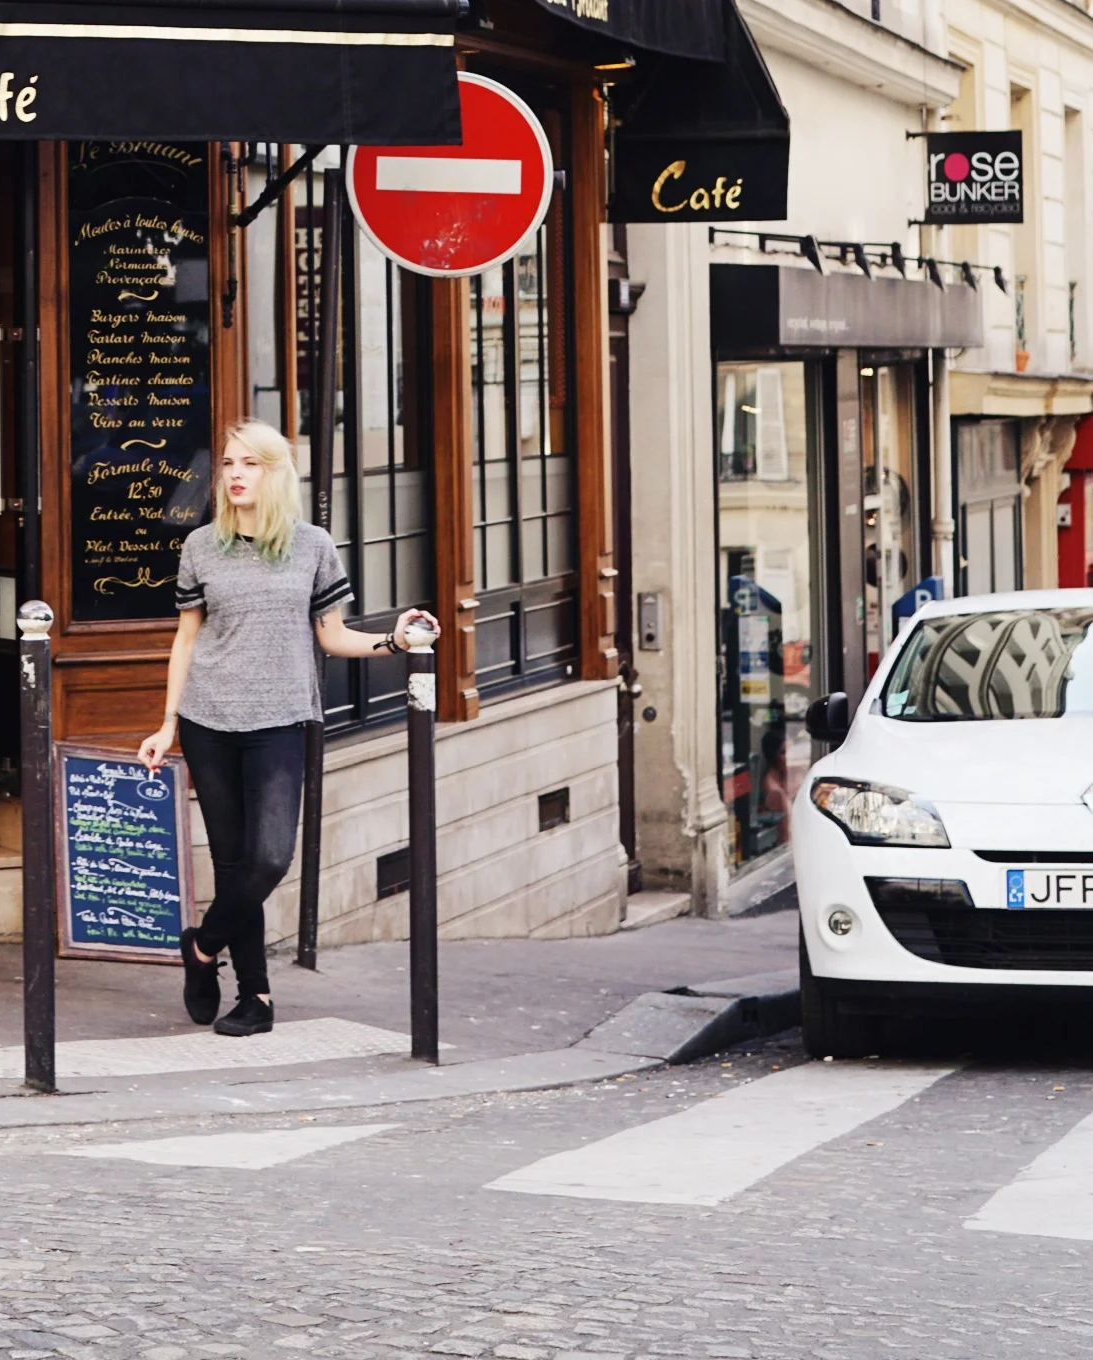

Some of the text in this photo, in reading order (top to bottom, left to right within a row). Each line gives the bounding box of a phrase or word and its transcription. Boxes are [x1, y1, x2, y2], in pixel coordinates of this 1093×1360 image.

[651, 159, 744, 214] Café
[930, 181, 1019, 202] BUNKER
[74, 219, 122, 246] Moules
[123, 215, 131, 228] à
[135, 213, 167, 230] toutes
[96, 271, 175, 286] Provençale
[90, 309, 139, 328] Burgers
[87, 332, 135, 344] Tartare
[87, 349, 143, 364] Planches
[86, 370, 194, 385] Tartines chaudes
[87, 392, 139, 407] Desserts
[90, 412, 185, 428] Vins au verre
[87, 458, 154, 485] Formule
[135, 526, 147, 535] ou
[915, 589, 933, 614] P
